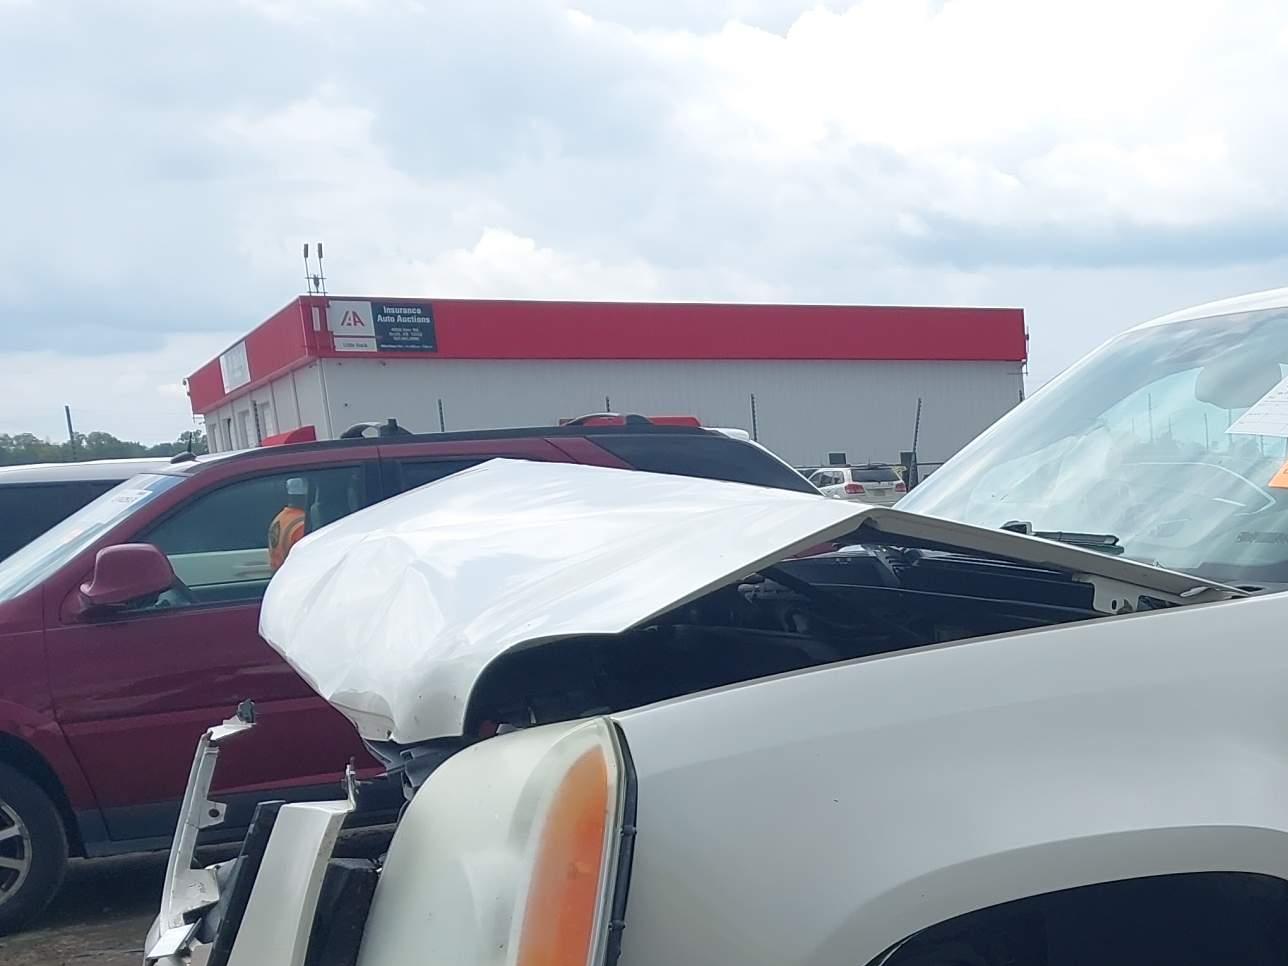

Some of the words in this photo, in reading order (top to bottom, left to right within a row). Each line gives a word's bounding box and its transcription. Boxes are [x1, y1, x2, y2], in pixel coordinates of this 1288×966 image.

[383, 305, 422, 314] Insurance
[377, 315, 395, 323] Auto
[396, 315, 431, 324] Auctions
